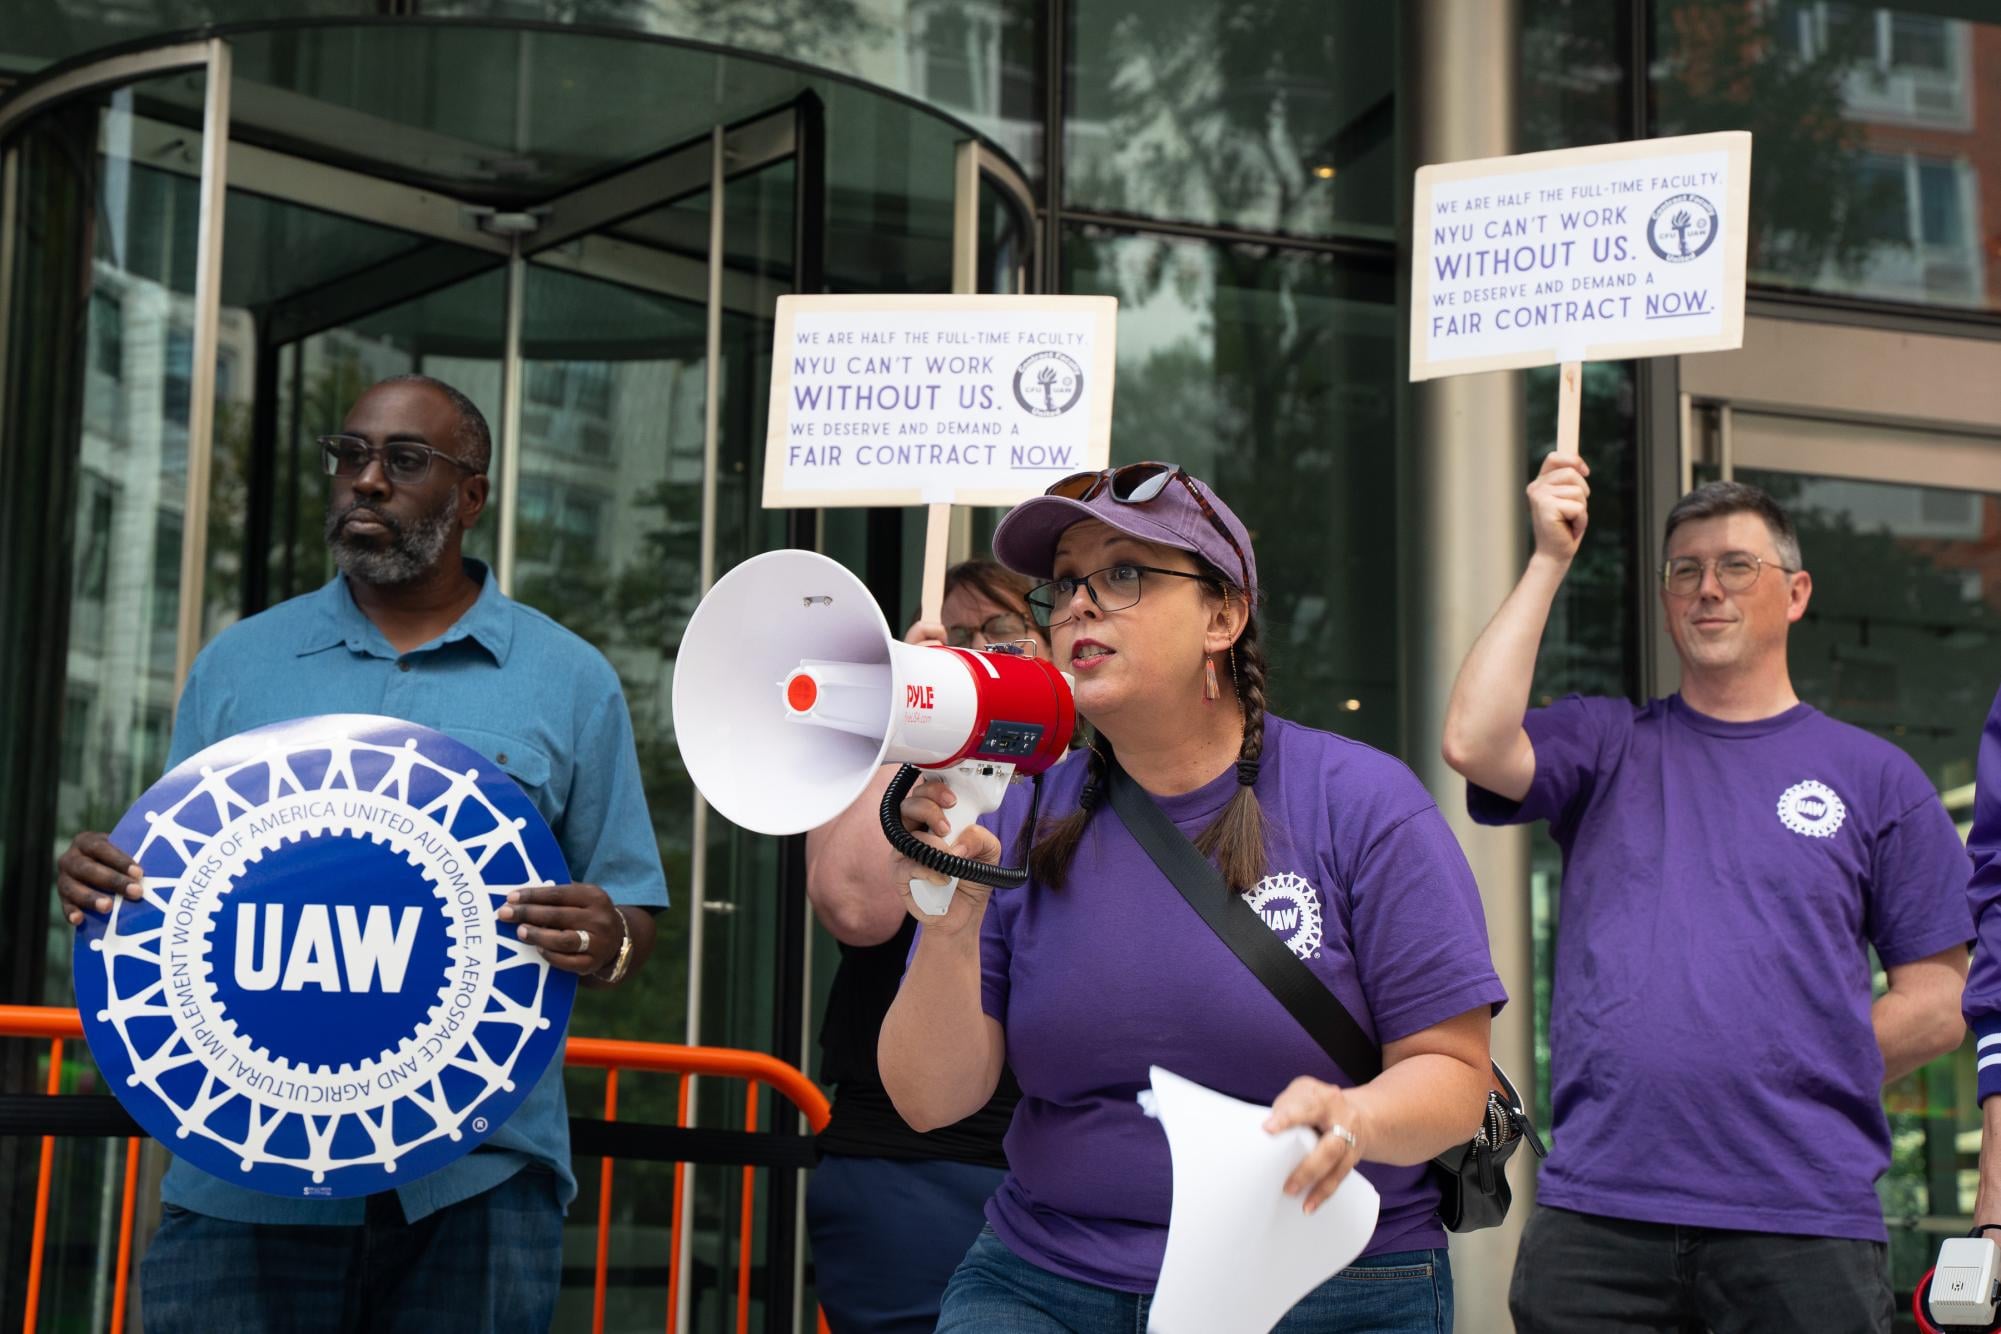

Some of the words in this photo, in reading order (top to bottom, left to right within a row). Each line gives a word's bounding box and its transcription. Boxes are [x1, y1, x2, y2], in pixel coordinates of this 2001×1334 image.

[1436, 200, 1457, 214] WE
[1464, 197, 1490, 211] ARE
[1497, 192, 1532, 208] HALF
[1538, 188, 1563, 203] THE
[1571, 179, 1644, 199] FULL-TIME
[1433, 224, 1474, 246] NYU
[1484, 215, 1548, 239] CAN'T
[1560, 206, 1628, 231] WORK
[1434, 241, 1576, 281] WITHOUT
[1592, 236, 1637, 263] US.
[1433, 292, 1456, 307] WE
[1463, 285, 1527, 304] DESERVE
[1535, 280, 1564, 295] AND
[1571, 274, 1637, 292] DEMAND
[1645, 271, 1655, 285] A
[1433, 313, 1482, 338] FAIR
[1495, 297, 1632, 330] CONTRACT
[1645, 289, 1716, 318] NOW.
[797, 332, 820, 345] WE
[827, 332, 854, 345] ARE
[860, 332, 896, 345] HALF
[904, 332, 930, 345] THE
[936, 331, 1011, 345] FULL-TIME
[794, 357, 836, 375] NYU
[847, 356, 913, 375] CAN'T
[925, 356, 994, 375] WORK
[793, 384, 941, 411] WITHOUT
[958, 384, 1003, 411] US.
[790, 422, 815, 436] WE
[823, 422, 889, 436] DESERVE
[898, 422, 929, 436] AND
[936, 421, 1002, 436] DEMAND
[1010, 422, 1020, 436] A
[789, 445, 842, 466] FAIR
[856, 444, 997, 466] CONTRACT
[1010, 445, 1080, 467] NOW.
[906, 684, 934, 709] PYLE
[249, 801, 336, 838] AMERICA
[343, 801, 415, 835] UNITED
[220, 832, 247, 857] OF
[171, 855, 223, 945] WORKERS
[414, 831, 482, 950] AUTOMOBILE,
[234, 902, 423, 993] UAW
[170, 951, 228, 1060] IMPLEMENT
[417, 955, 481, 1062] AEROSPACE
[227, 1054, 371, 1103] AGRICULTURAL
[377, 1056, 418, 1090] AND
